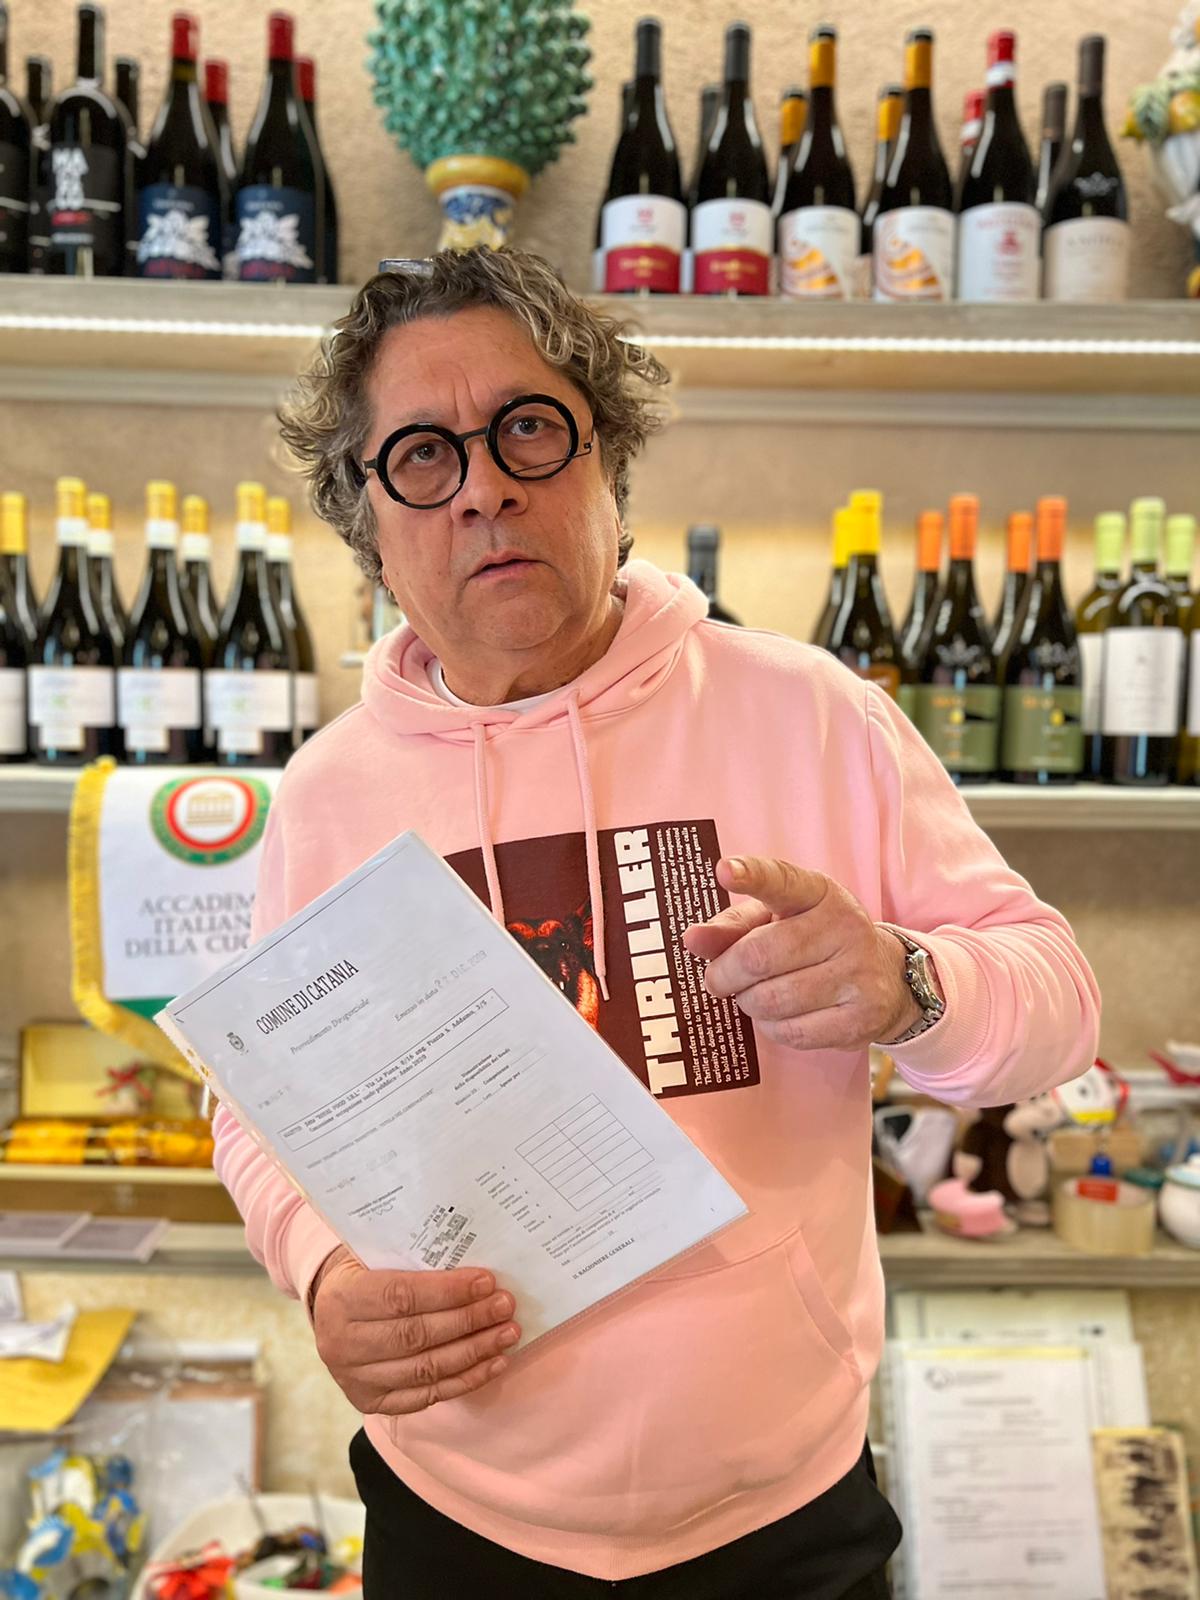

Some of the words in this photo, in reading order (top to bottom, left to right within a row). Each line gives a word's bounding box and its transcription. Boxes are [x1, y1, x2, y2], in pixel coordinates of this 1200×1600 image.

[656, 829, 666, 862] subgenres.
[666, 828, 674, 858] suspense,
[672, 827, 683, 855] expected
[681, 827, 689, 842] calls
[693, 834, 701, 851] genre
[668, 858, 675, 867] of
[686, 861, 694, 873] and
[694, 853, 702, 864] this
[705, 857, 714, 877] EVIL.
[661, 863, 669, 887] various
[671, 868, 680, 894] feelings
[679, 864, 687, 886] viewer
[700, 874, 708, 888] type
[664, 888, 674, 915] includes
[684, 887, 693, 916] thickens,
[690, 874, 700, 907] Cover-ups
[139, 893, 254, 917] ACCADEM
[673, 895, 684, 921] forceful
[702, 889, 712, 917] common
[154, 914, 251, 934] ITALIAN
[669, 916, 677, 934] often
[125, 938, 197, 957] DELLA
[614, 828, 688, 1095] THRILLER
[672, 942, 684, 978] FICTION.
[683, 949, 696, 994] EMOTIONS
[678, 981, 686, 989] of
[256, 998, 301, 1035] COMUNE
[292, 990, 313, 1010] DI
[306, 960, 359, 1000] CATANIA
[680, 990, 691, 1020] GENRE
[692, 995, 700, 1013] raise
[701, 993, 709, 1010] even
[731, 998, 739, 1016] story
[703, 1012, 711, 1025] and
[722, 998, 732, 1030] elements
[696, 1024, 705, 1046] meant
[706, 1027, 715, 1047] doubt
[715, 1022, 723, 1033] his
[735, 1018, 743, 1041] driven
[689, 1036, 698, 1056] refers
[719, 1035, 724, 1043] to
[720, 1044, 726, 1054] on
[727, 1032, 738, 1067] important
[693, 1058, 702, 1086] Thriller
[702, 1056, 712, 1085] Thriller
[711, 1049, 722, 1083] curiosity,
[720, 1056, 730, 1072] hold
[738, 1043, 749, 1079] VILLAIN
[726, 1074, 731, 1082] to
